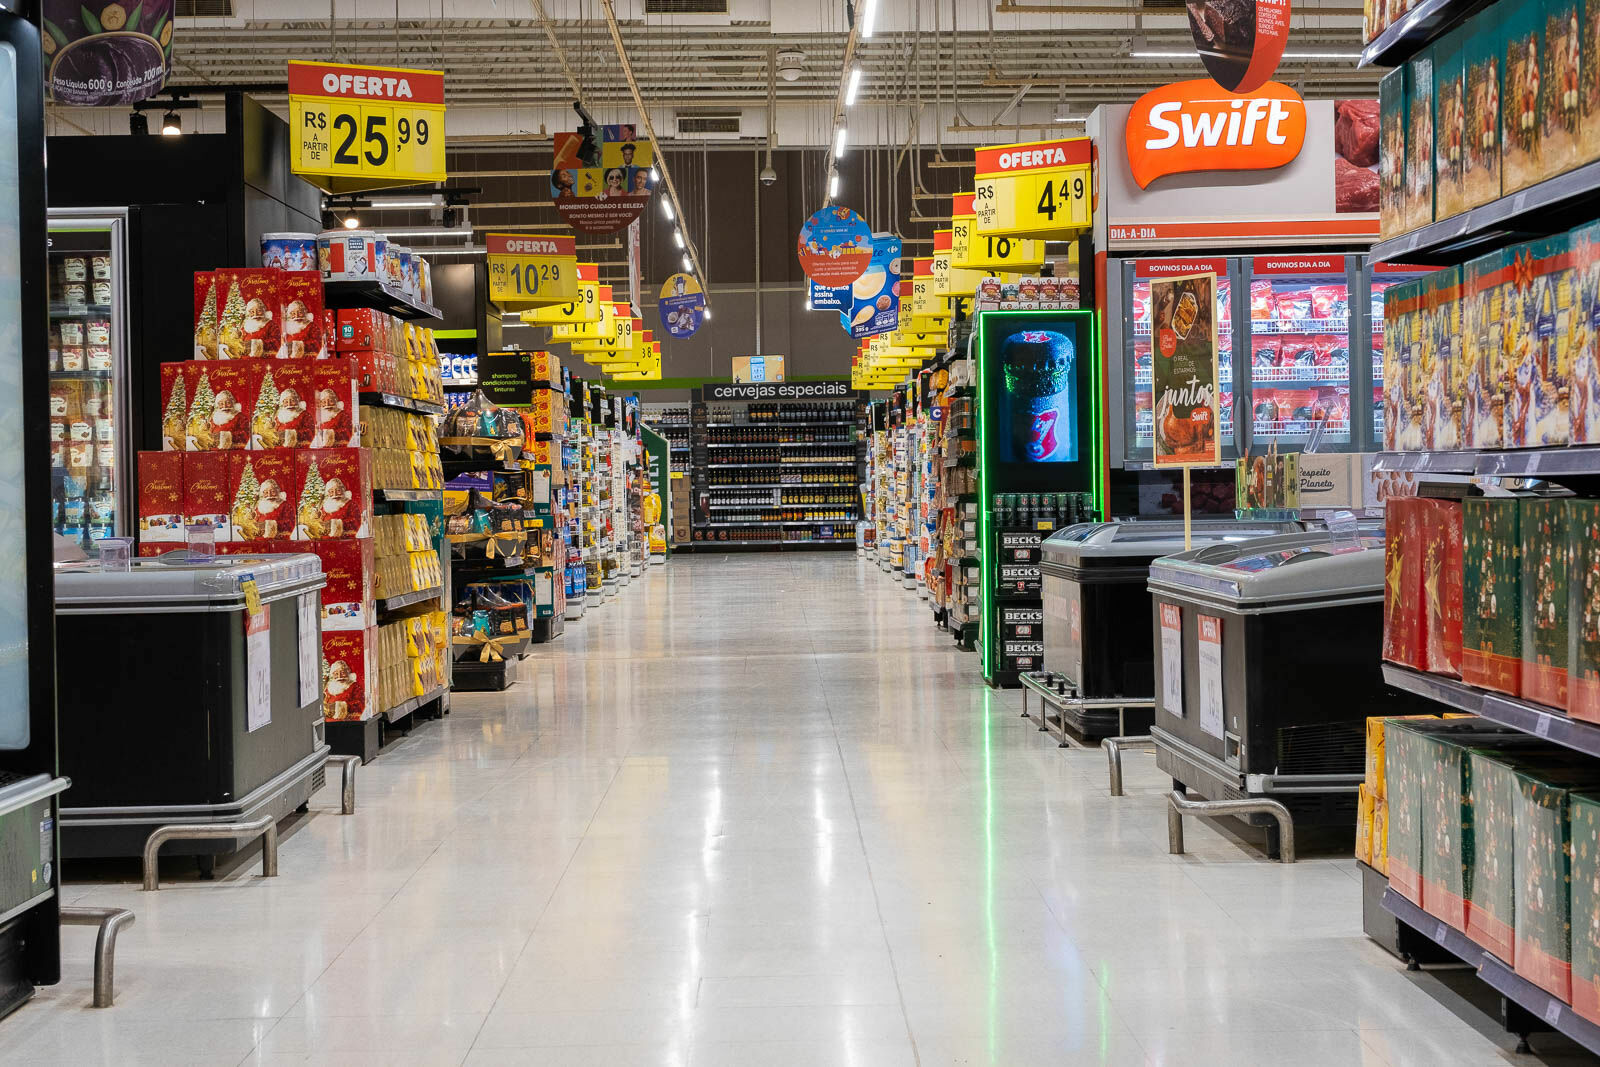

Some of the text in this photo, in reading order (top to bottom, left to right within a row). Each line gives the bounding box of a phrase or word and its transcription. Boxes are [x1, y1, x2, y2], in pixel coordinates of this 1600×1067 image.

[54, 76, 65, 85] Peso
[66, 79, 88, 90] Líquido
[88, 78, 105, 90] 600
[107, 80, 112, 92] g
[116, 77, 142, 88] Conteúdo
[144, 68, 156, 81] 700
[322, 73, 413, 98] OFERTA
[304, 111, 326, 130] R$
[1146, 98, 1290, 150] Swift
[333, 114, 429, 166] 25,99
[303, 141, 328, 152] PARTIR
[310, 152, 320, 160] DE
[999, 148, 1066, 169] OFERTA
[978, 185, 994, 200] R$
[1037, 178, 1084, 221] 4,49
[978, 207, 996, 216] PARTIR
[955, 226, 967, 237] R$
[1111, 228, 1156, 239] DIA-A-DIA
[506, 239, 558, 253] OFERTA
[492, 264, 506, 274] R$
[936, 260, 948, 270] R$
[510, 264, 560, 295] 10,29
[914, 284, 926, 294] R$
[902, 304, 912, 312] R$
[714, 382, 847, 399] cervejas especiais
[1158, 375, 1213, 419] juntos
[1191, 411, 1208, 422] Swift
[1004, 536, 1041, 544] BECK'S
[1003, 568, 1040, 576] BECK'S
[1005, 612, 1042, 620] BECK'S
[1006, 644, 1043, 652] BECK'S
